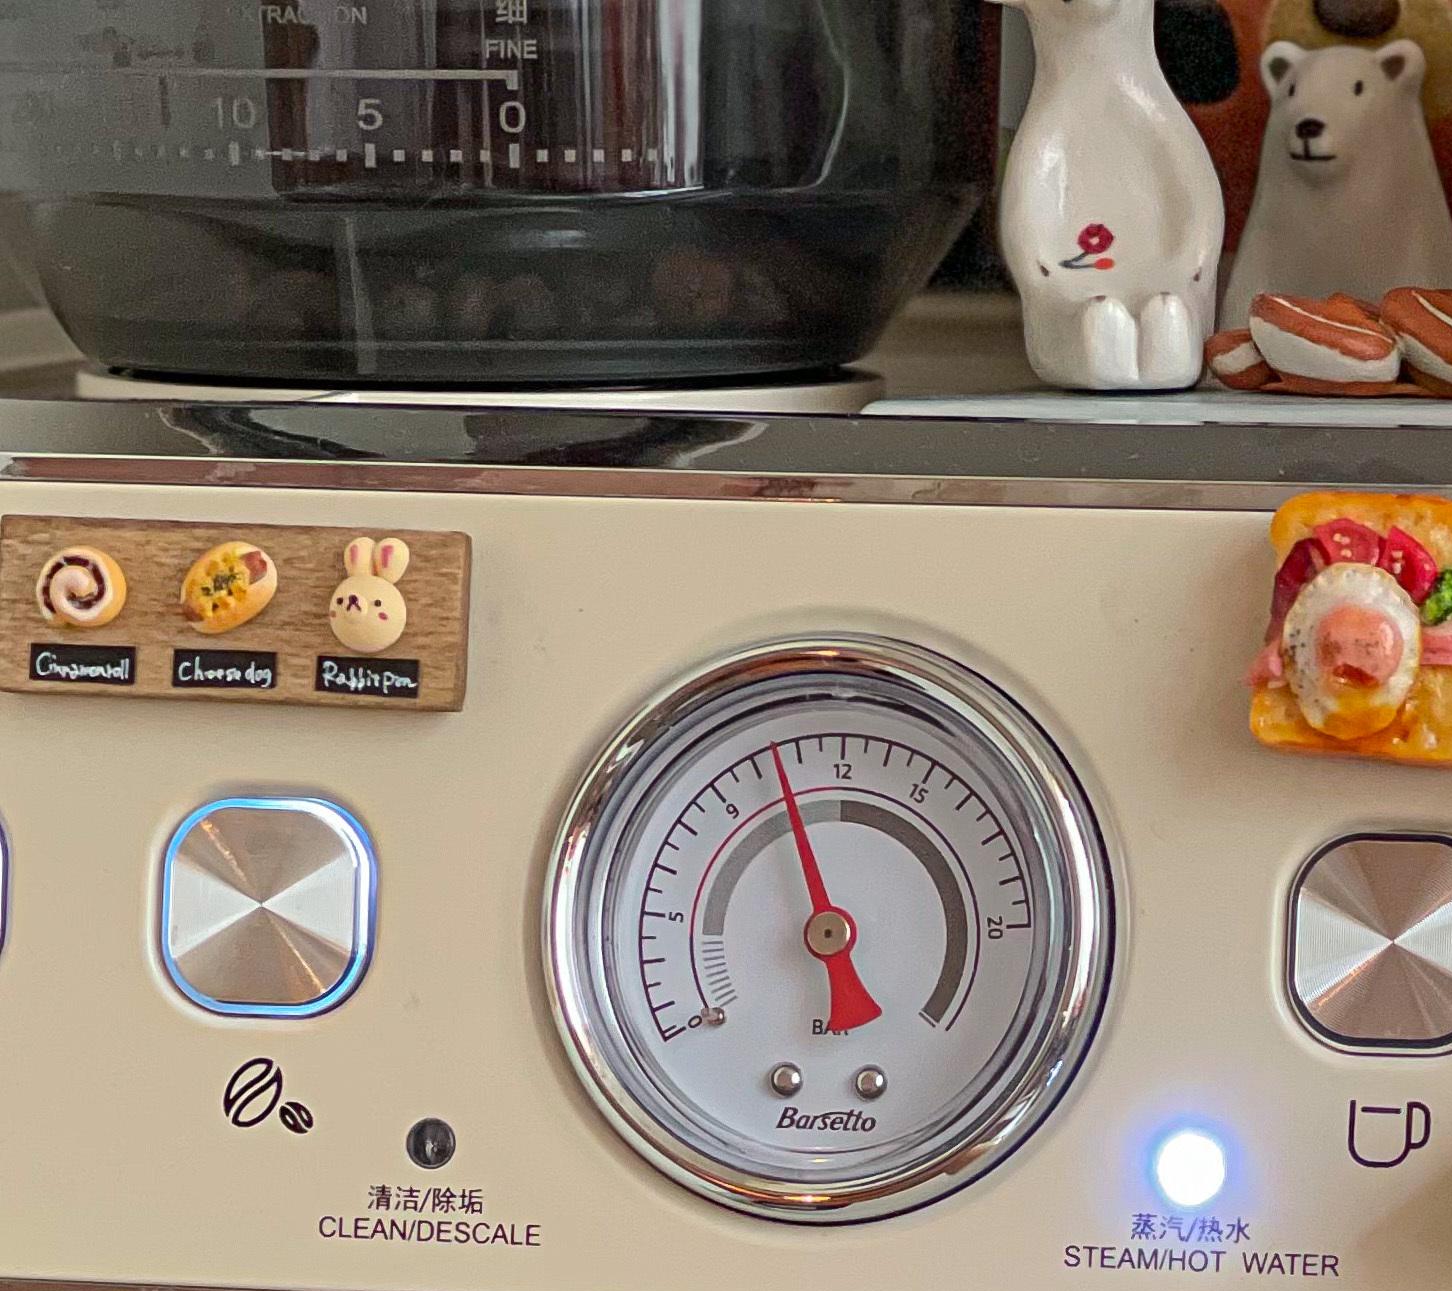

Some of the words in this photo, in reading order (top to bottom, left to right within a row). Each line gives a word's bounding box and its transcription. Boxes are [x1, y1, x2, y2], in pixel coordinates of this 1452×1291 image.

[485, 38, 538, 60] FINE
[357, 98, 384, 131] 5
[499, 101, 527, 134] 0
[833, 763, 853, 780] 12
[908, 782, 930, 805] 15
[724, 803, 741, 820] 9
[667, 910, 685, 924] 5
[986, 915, 1004, 940] 20
[775, 1106, 878, 1133] Barsetto
[367, 1184, 485, 1215] 清洁/除垢
[318, 1215, 543, 1247] CLEAN/DESCALE
[1130, 1212, 1252, 1244] 蒸汽/热水
[1063, 1244, 1227, 1273] STEAM/HOT
[1241, 1251, 1340, 1277] WATER
